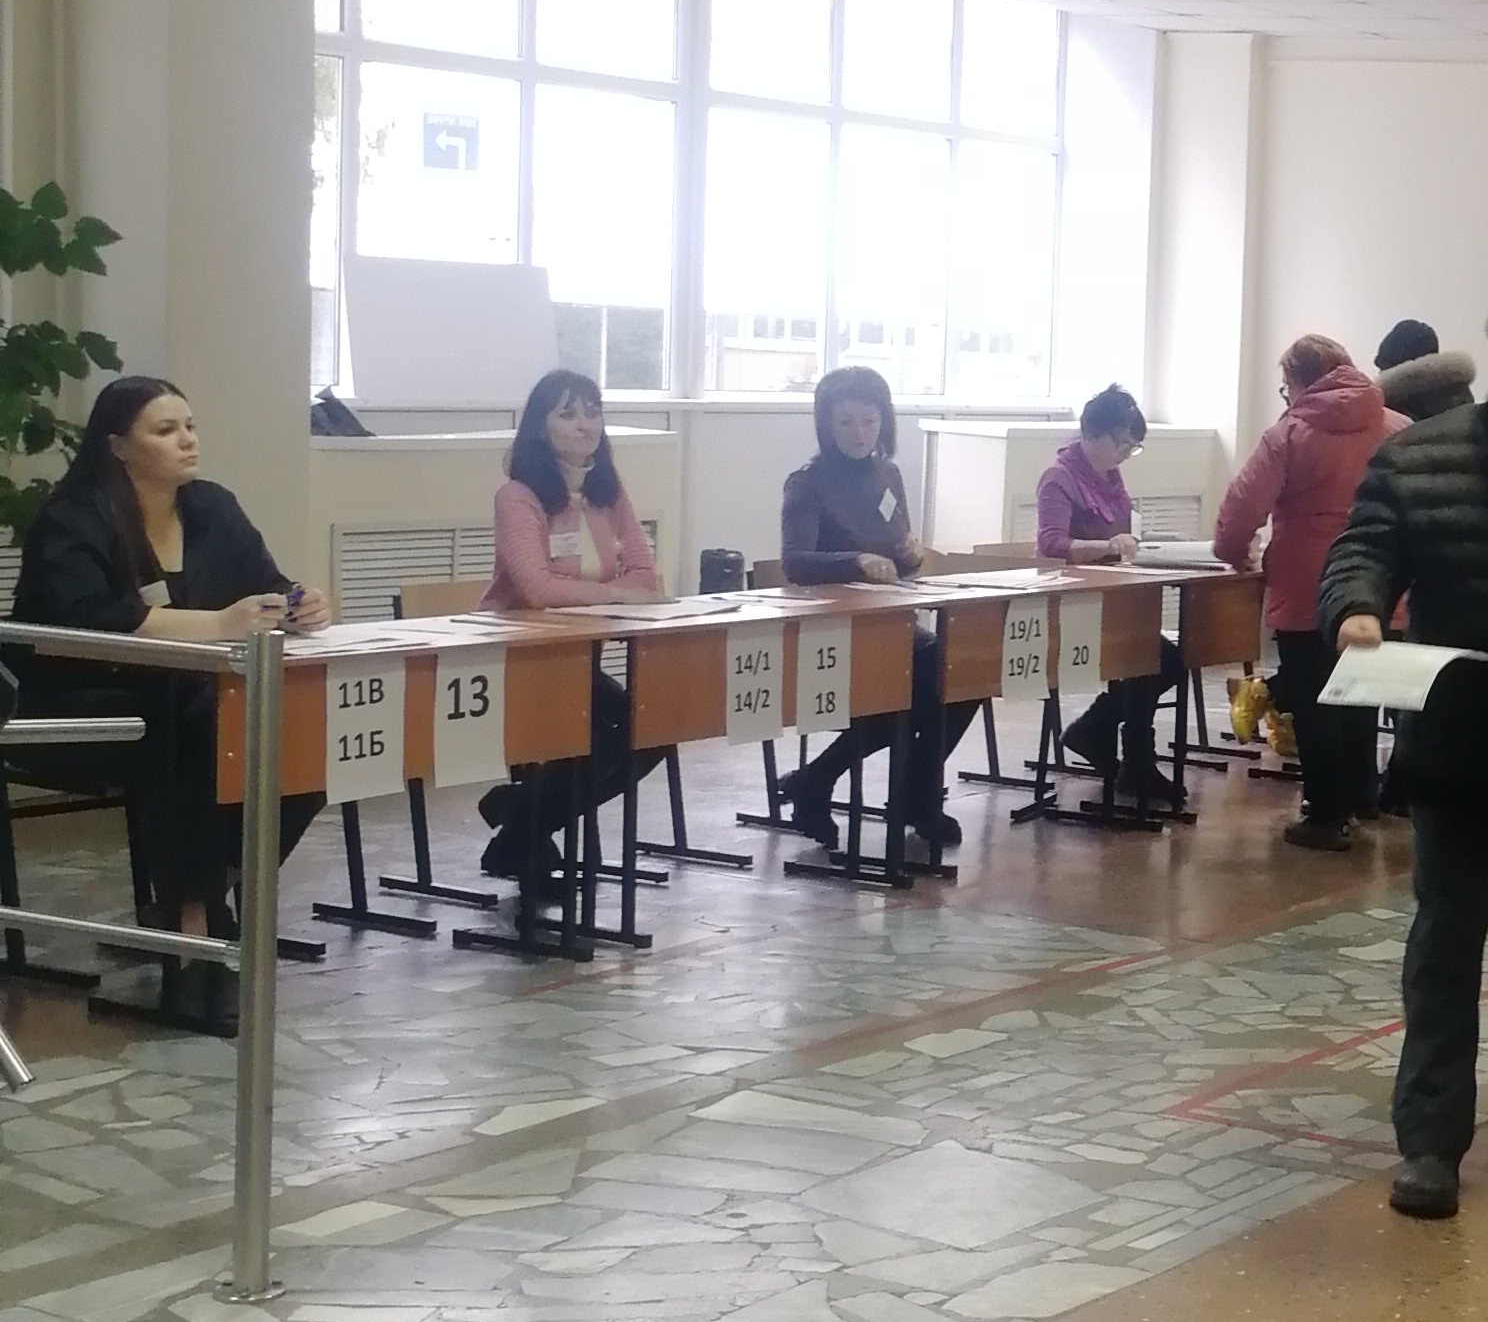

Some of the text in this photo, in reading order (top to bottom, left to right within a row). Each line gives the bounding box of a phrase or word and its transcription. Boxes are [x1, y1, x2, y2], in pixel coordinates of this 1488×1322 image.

[1009, 617, 1041, 642] 19/1
[735, 650, 771, 676] 14/1
[816, 646, 837, 670] 15
[1008, 653, 1040, 679] 19/2
[1072, 645, 1090, 666] 20
[338, 678, 385, 709] 11В
[446, 675, 490, 720] 13
[734, 688, 771, 714] 14/2
[815, 691, 836, 715] 18
[338, 730, 385, 762] 11Б
